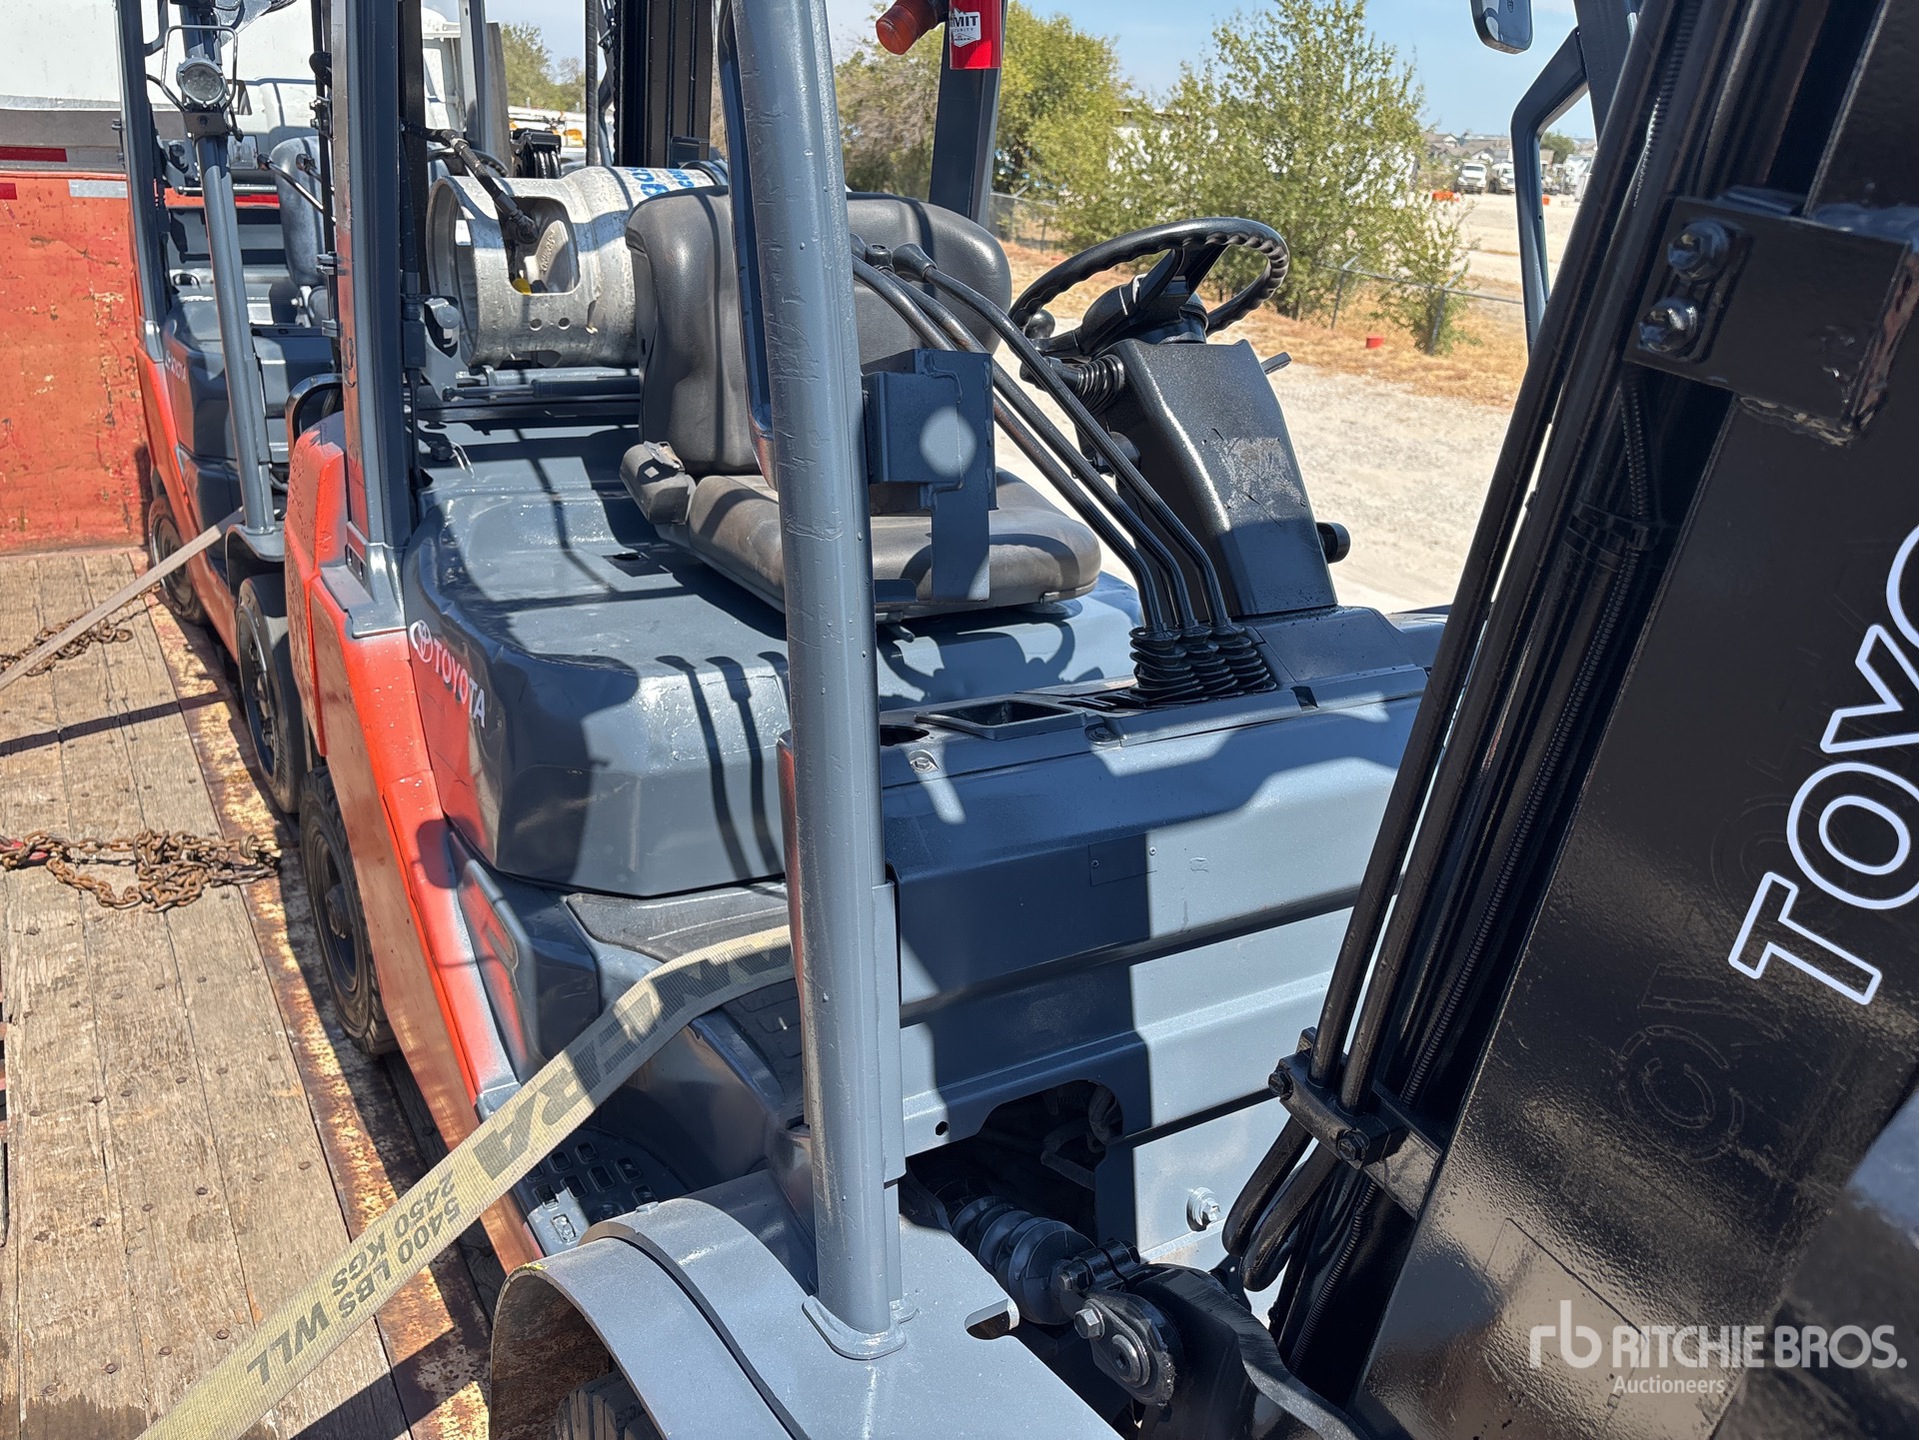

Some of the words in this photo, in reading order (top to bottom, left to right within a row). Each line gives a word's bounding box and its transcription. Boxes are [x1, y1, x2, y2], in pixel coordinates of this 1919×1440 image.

[433, 637, 486, 729] TOYOTA
[394, 1169, 456, 1238] 2450
[399, 1198, 461, 1264] 5400
[331, 1231, 387, 1297] KGS
[337, 1259, 391, 1319] LBS
[246, 1302, 330, 1385] WLL
